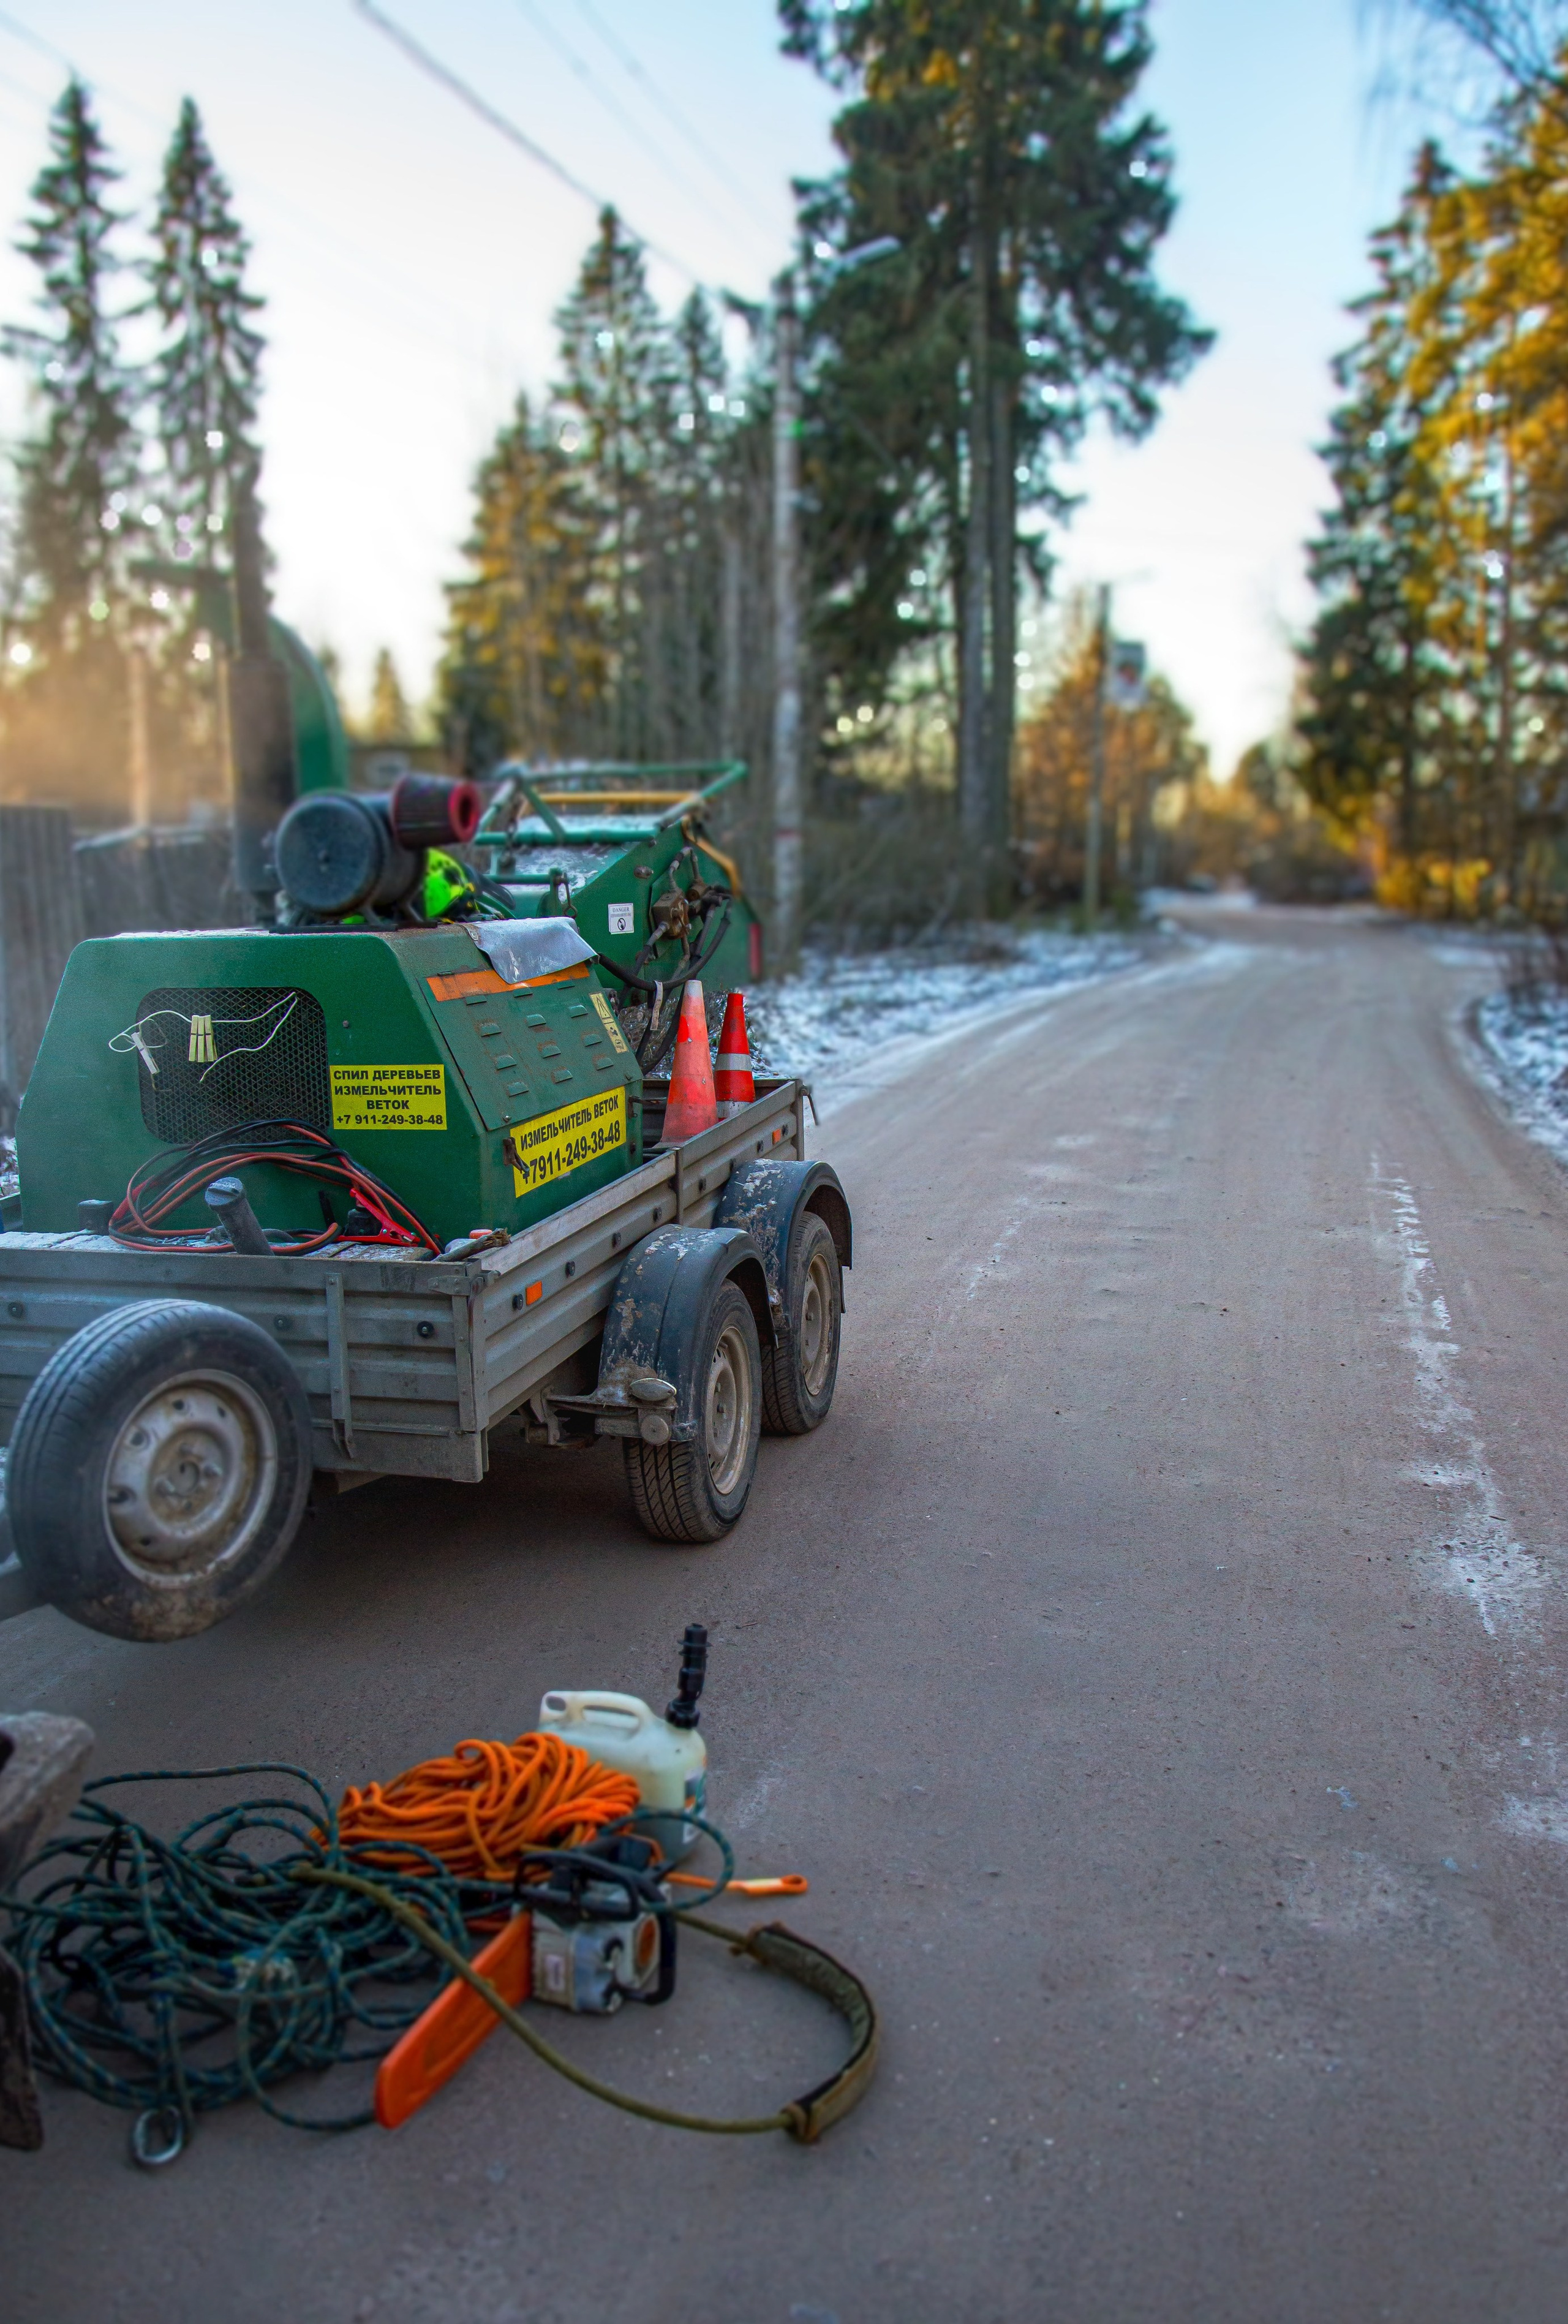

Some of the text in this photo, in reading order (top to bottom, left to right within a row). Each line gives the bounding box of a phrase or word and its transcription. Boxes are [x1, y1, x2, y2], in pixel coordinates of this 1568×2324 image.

[334, 1070, 441, 1081] СПИЛ ДЕРЕВЬЕВ
[334, 1085, 442, 1096] ИЗМЕЛЬЧИТЕЛЬ
[367, 1100, 410, 1110] ВЕТОК
[337, 1115, 443, 1125] +7 911-249-38-48
[521, 1095, 619, 1152] ИЗМЕЛЬЧИТЕЛЬ ВЕТОК
